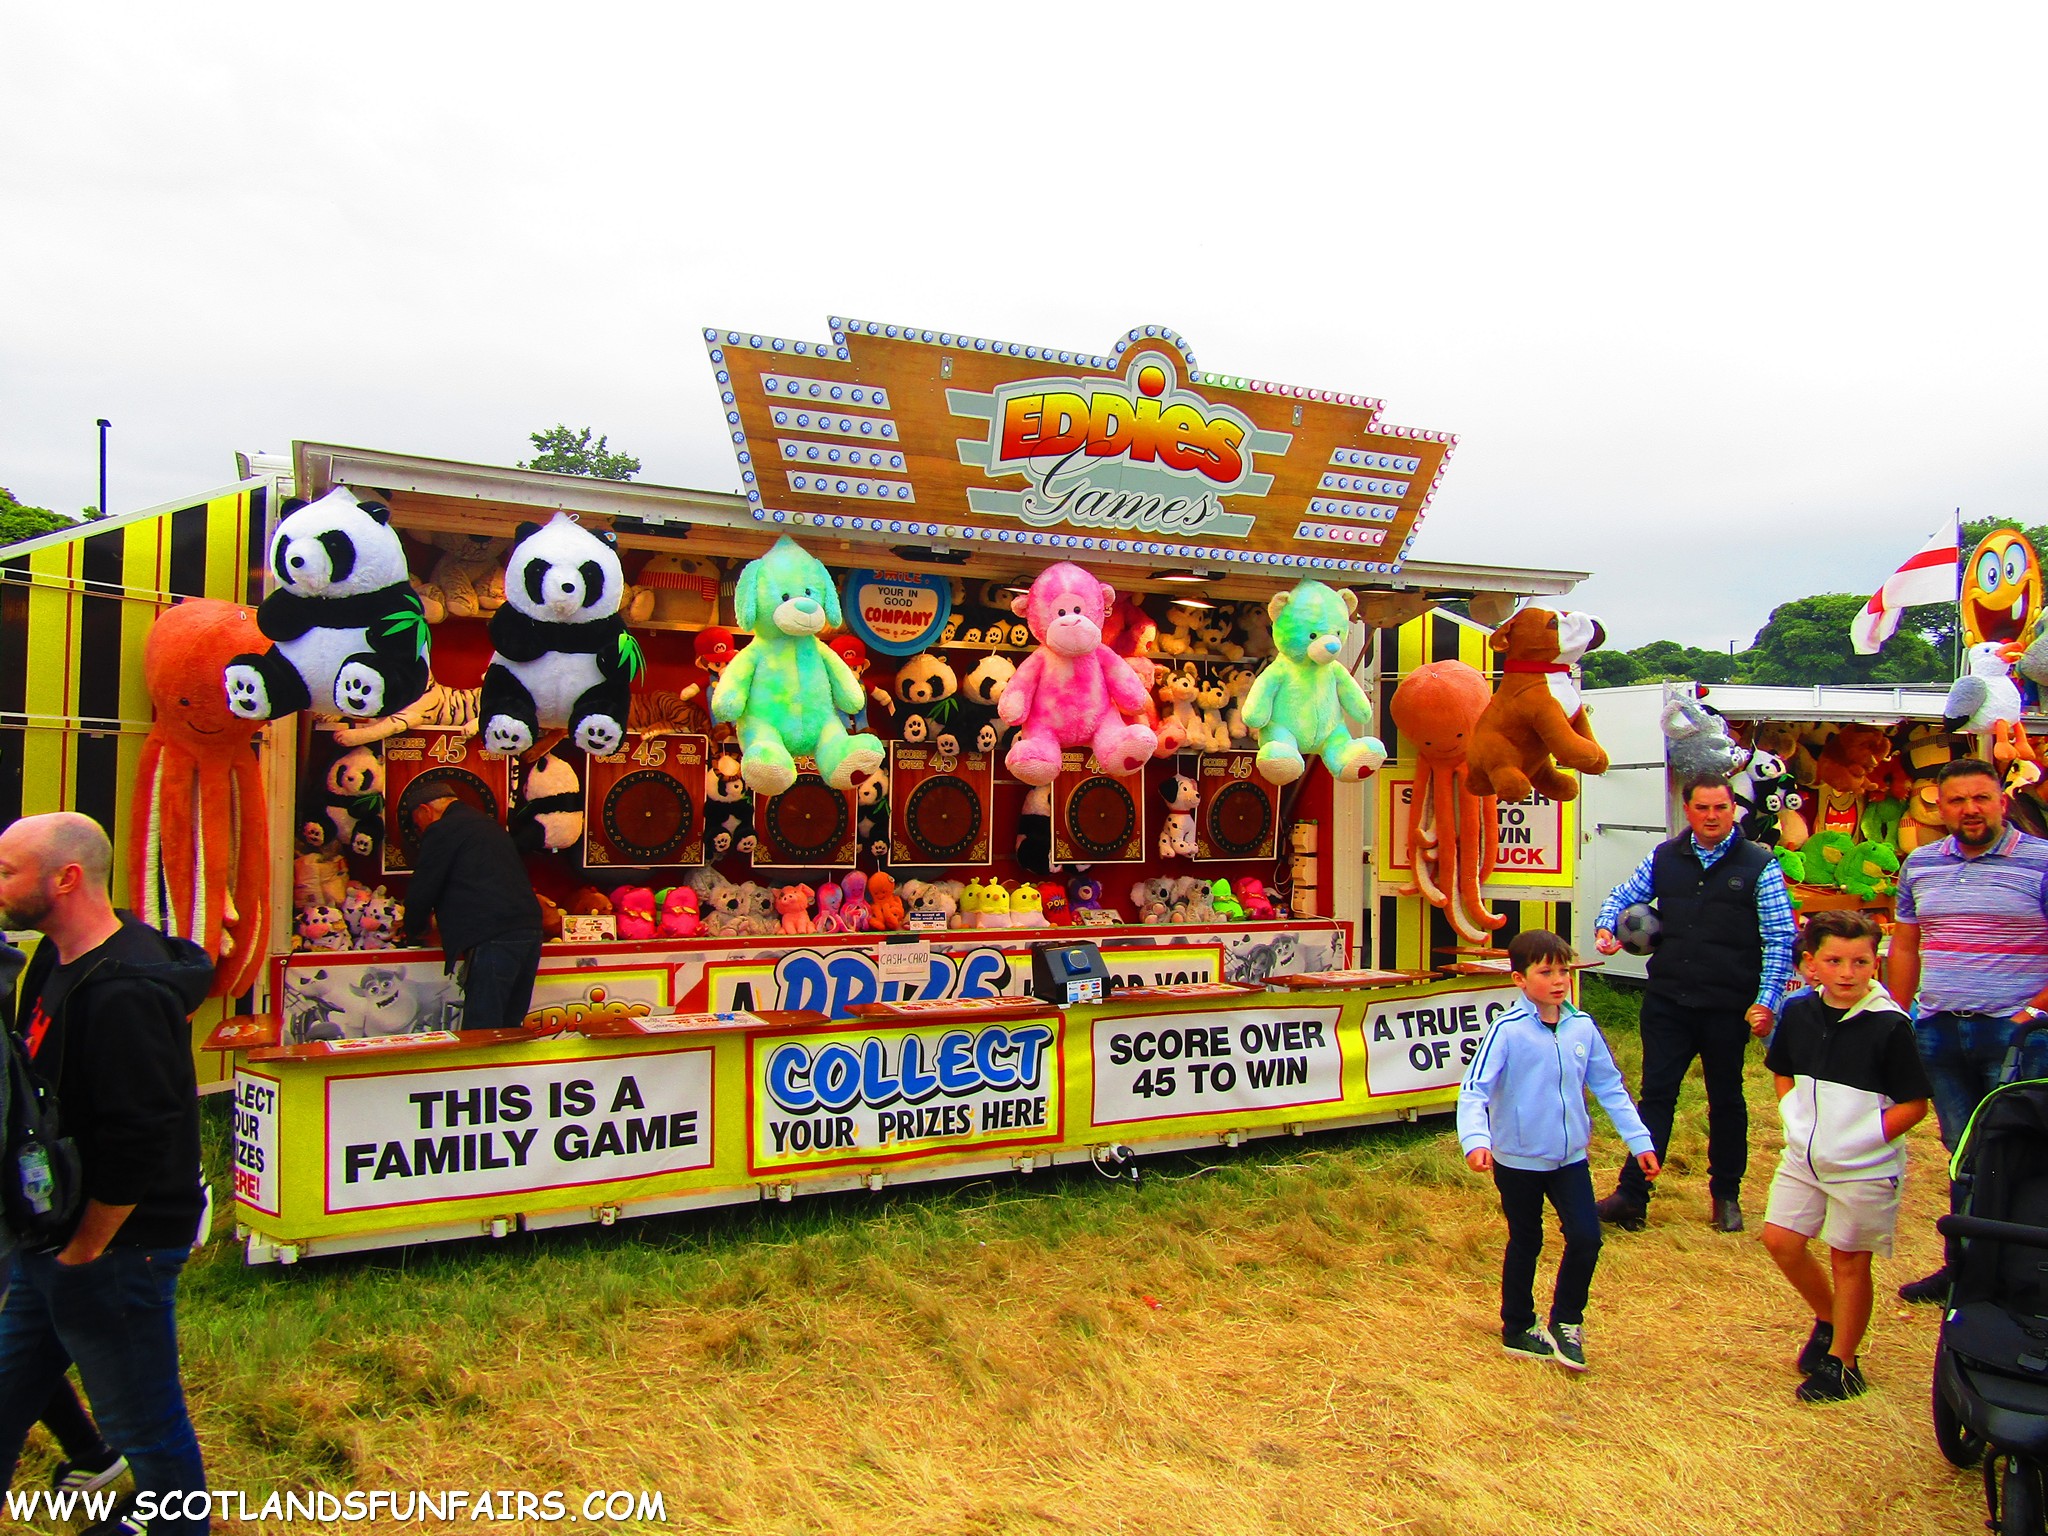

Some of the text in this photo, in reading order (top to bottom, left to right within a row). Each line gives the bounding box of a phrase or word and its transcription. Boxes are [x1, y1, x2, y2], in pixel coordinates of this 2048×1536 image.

[1025, 436, 1216, 527] Games
[878, 587, 918, 598] YOUR IN
[884, 598, 913, 607] GOOD
[865, 607, 933, 626] COMPANY
[428, 734, 467, 763] 45
[631, 739, 666, 766] 45
[1228, 755, 1253, 778] 45
[1374, 1001, 1517, 1041] A TRUE G
[1110, 1021, 1325, 1065] SCORE OVER
[1409, 1037, 1483, 1071] OF S
[766, 1025, 1053, 1113] COLLECT
[1132, 1056, 1308, 1098] 45 TO WIN
[410, 1076, 645, 1129] THIS IS A
[770, 1097, 1046, 1152] YOUR PRIZES HERE
[345, 1111, 699, 1183] FAMILY GAME
